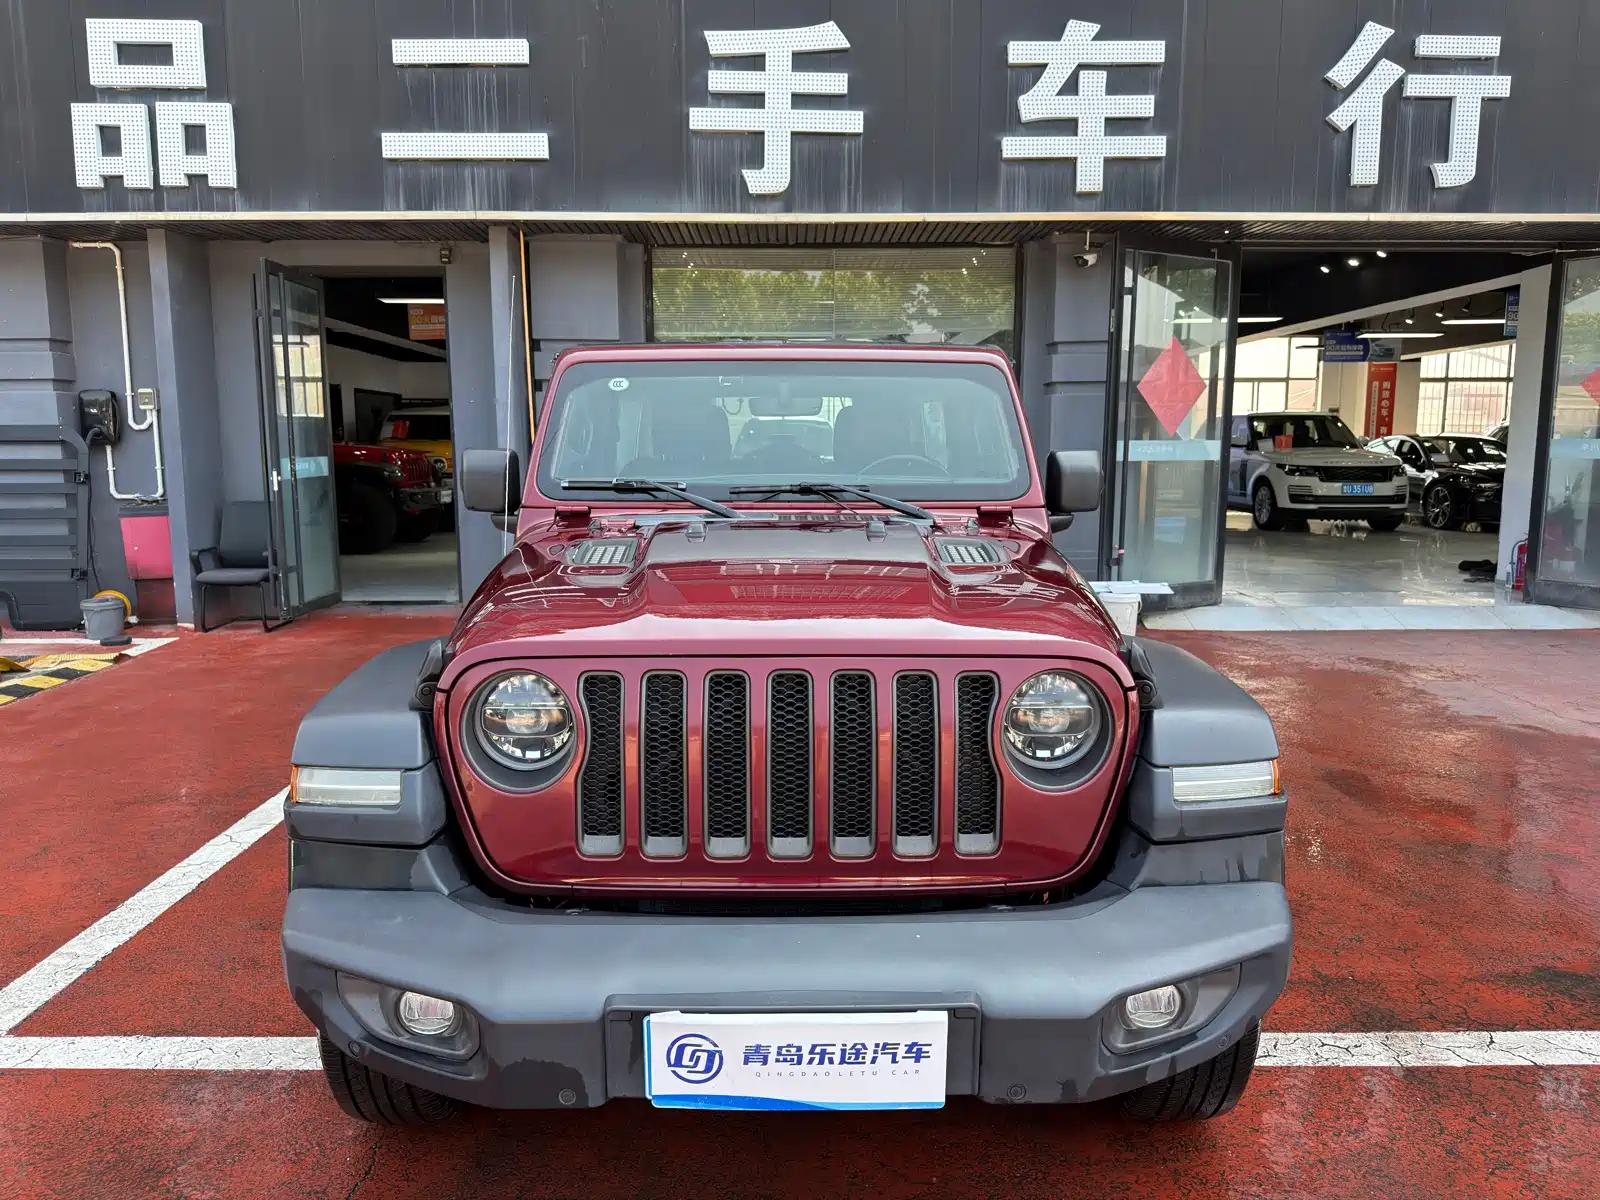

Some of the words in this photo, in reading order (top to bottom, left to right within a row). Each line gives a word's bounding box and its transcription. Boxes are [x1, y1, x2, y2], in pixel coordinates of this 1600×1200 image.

[742, 1041, 932, 1066] 青岛乐途汽车
[891, 1069, 920, 1077] CAR
